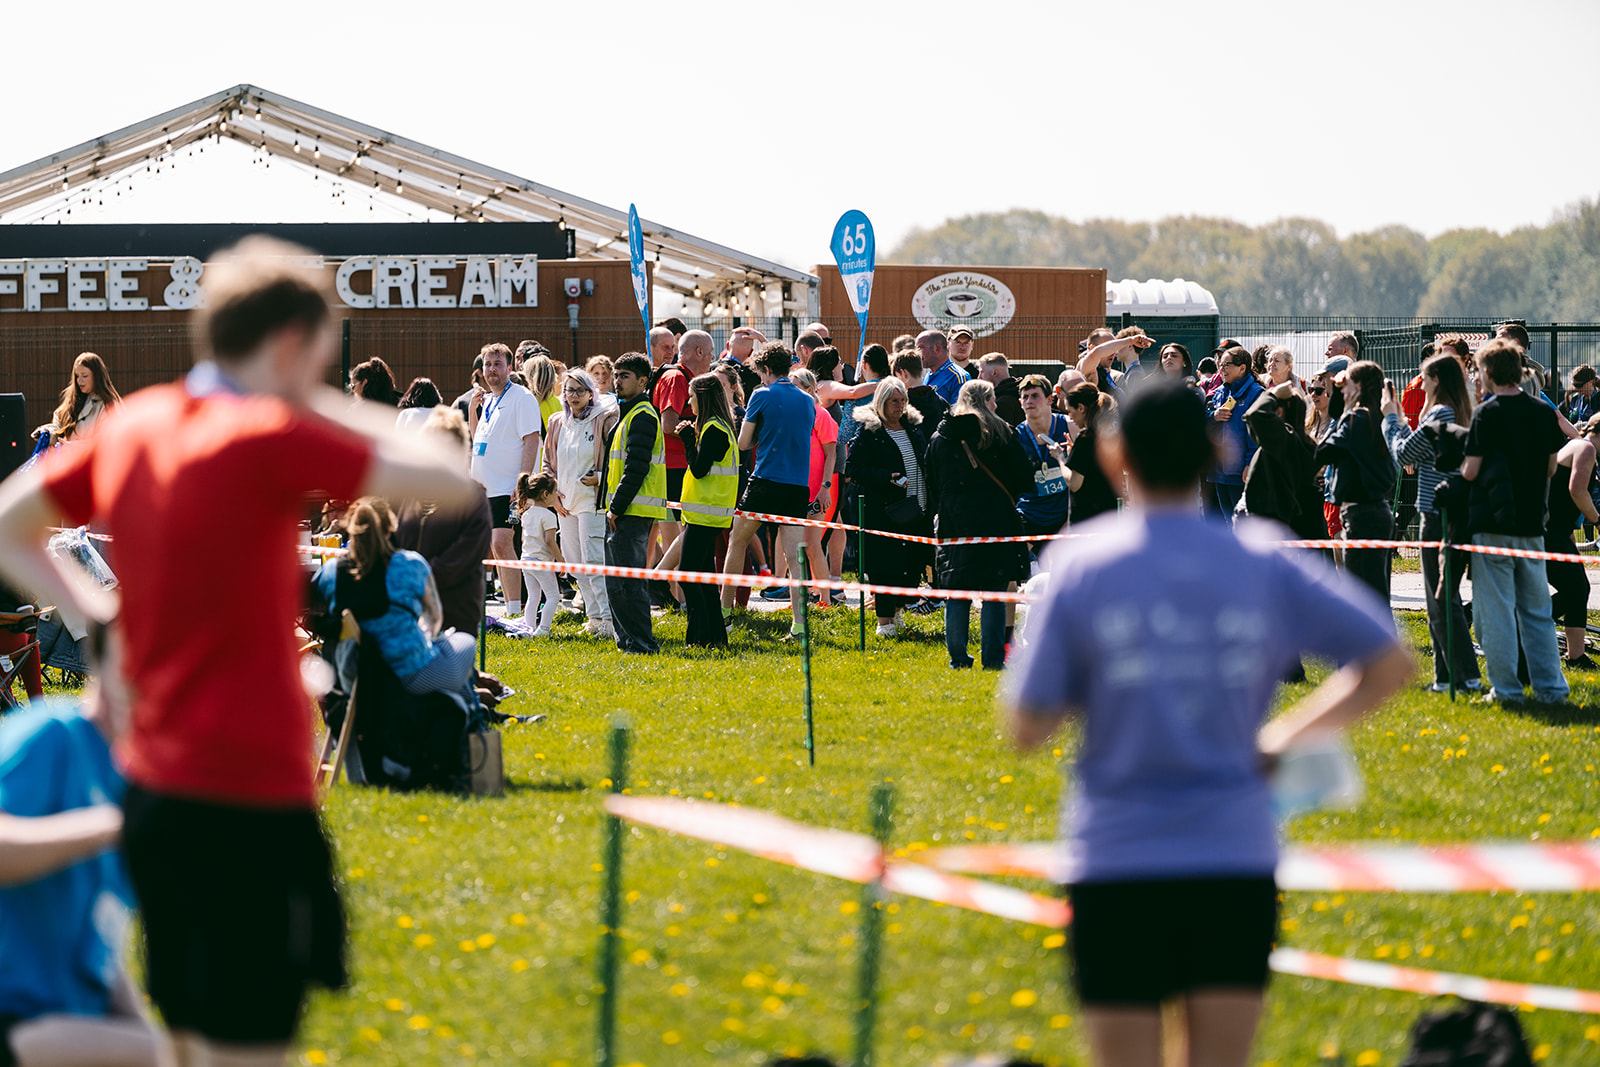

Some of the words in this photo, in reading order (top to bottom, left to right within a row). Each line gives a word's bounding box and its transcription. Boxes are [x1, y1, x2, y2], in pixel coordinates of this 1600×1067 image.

[843, 223, 866, 256] 65
[842, 258, 868, 270] minutes
[336, 254, 538, 308] CREAM
[925, 284, 941, 296] The
[940, 277, 963, 288] Little
[963, 275, 999, 295] Yorkshire
[1044, 481, 1064, 494] 134
